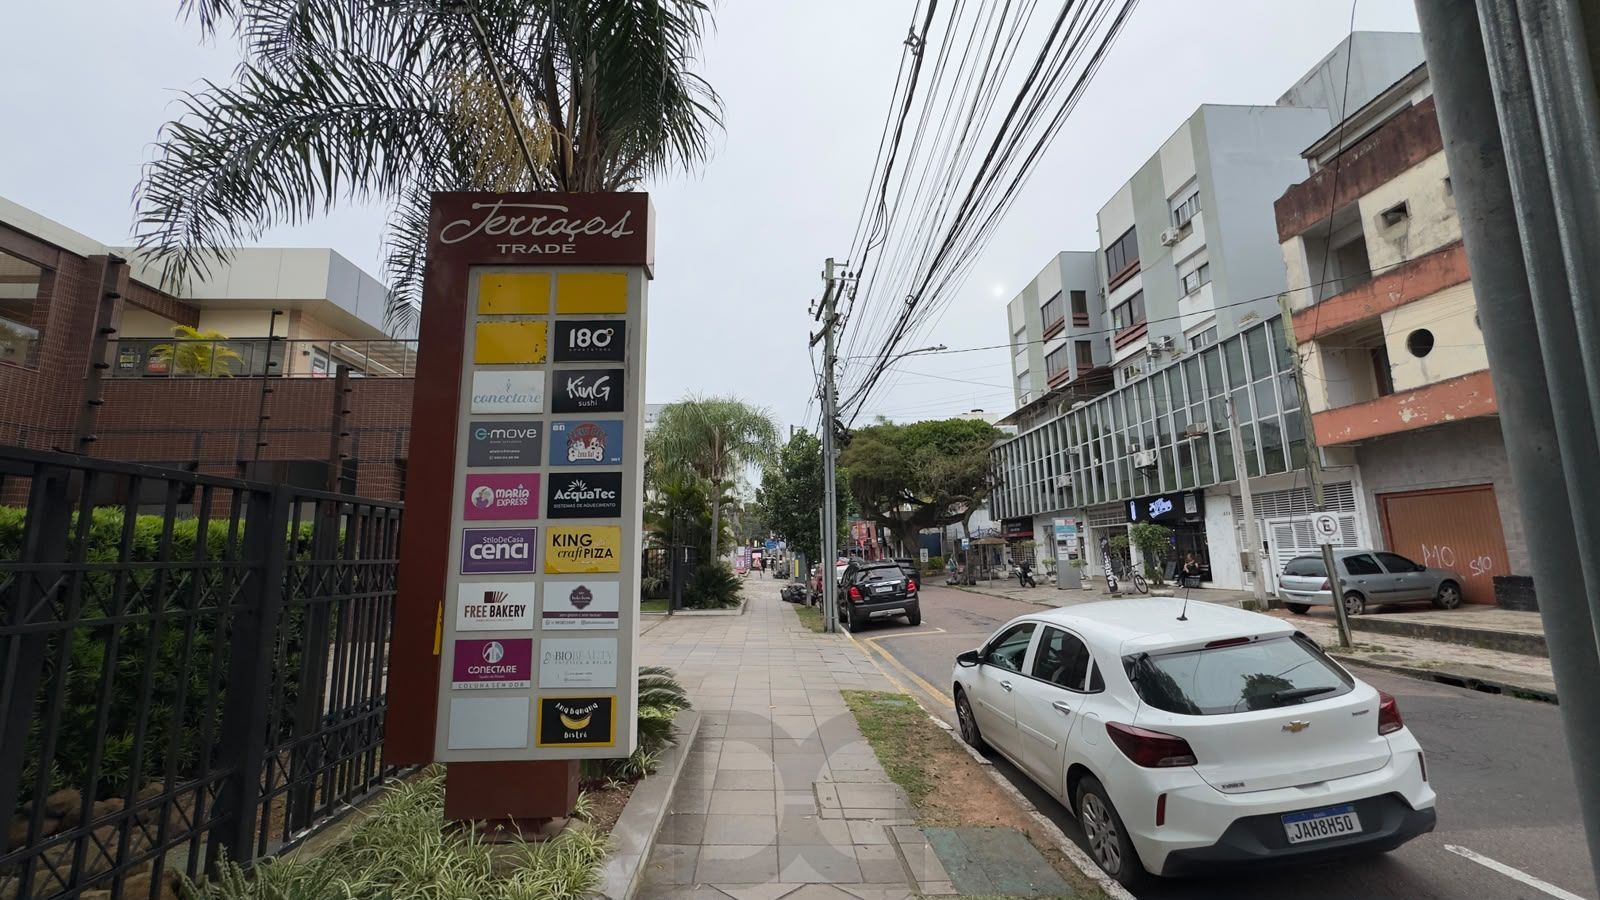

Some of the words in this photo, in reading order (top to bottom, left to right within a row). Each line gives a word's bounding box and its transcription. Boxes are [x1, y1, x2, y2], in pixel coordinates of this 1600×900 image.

[439, 200, 634, 244] Terraços
[497, 243, 576, 254] TRADE
[473, 392, 541, 404] conectare
[553, 487, 616, 502] AcquaTec
[496, 497, 529, 507] EXPRESS
[552, 533, 593, 547] KING
[469, 542, 529, 560] cenci
[557, 546, 583, 562] craft
[583, 548, 614, 559] PIZZA
[464, 605, 488, 618] FREE
[489, 604, 527, 618] BAKERY
[1293, 814, 1354, 840] JAH8H50
